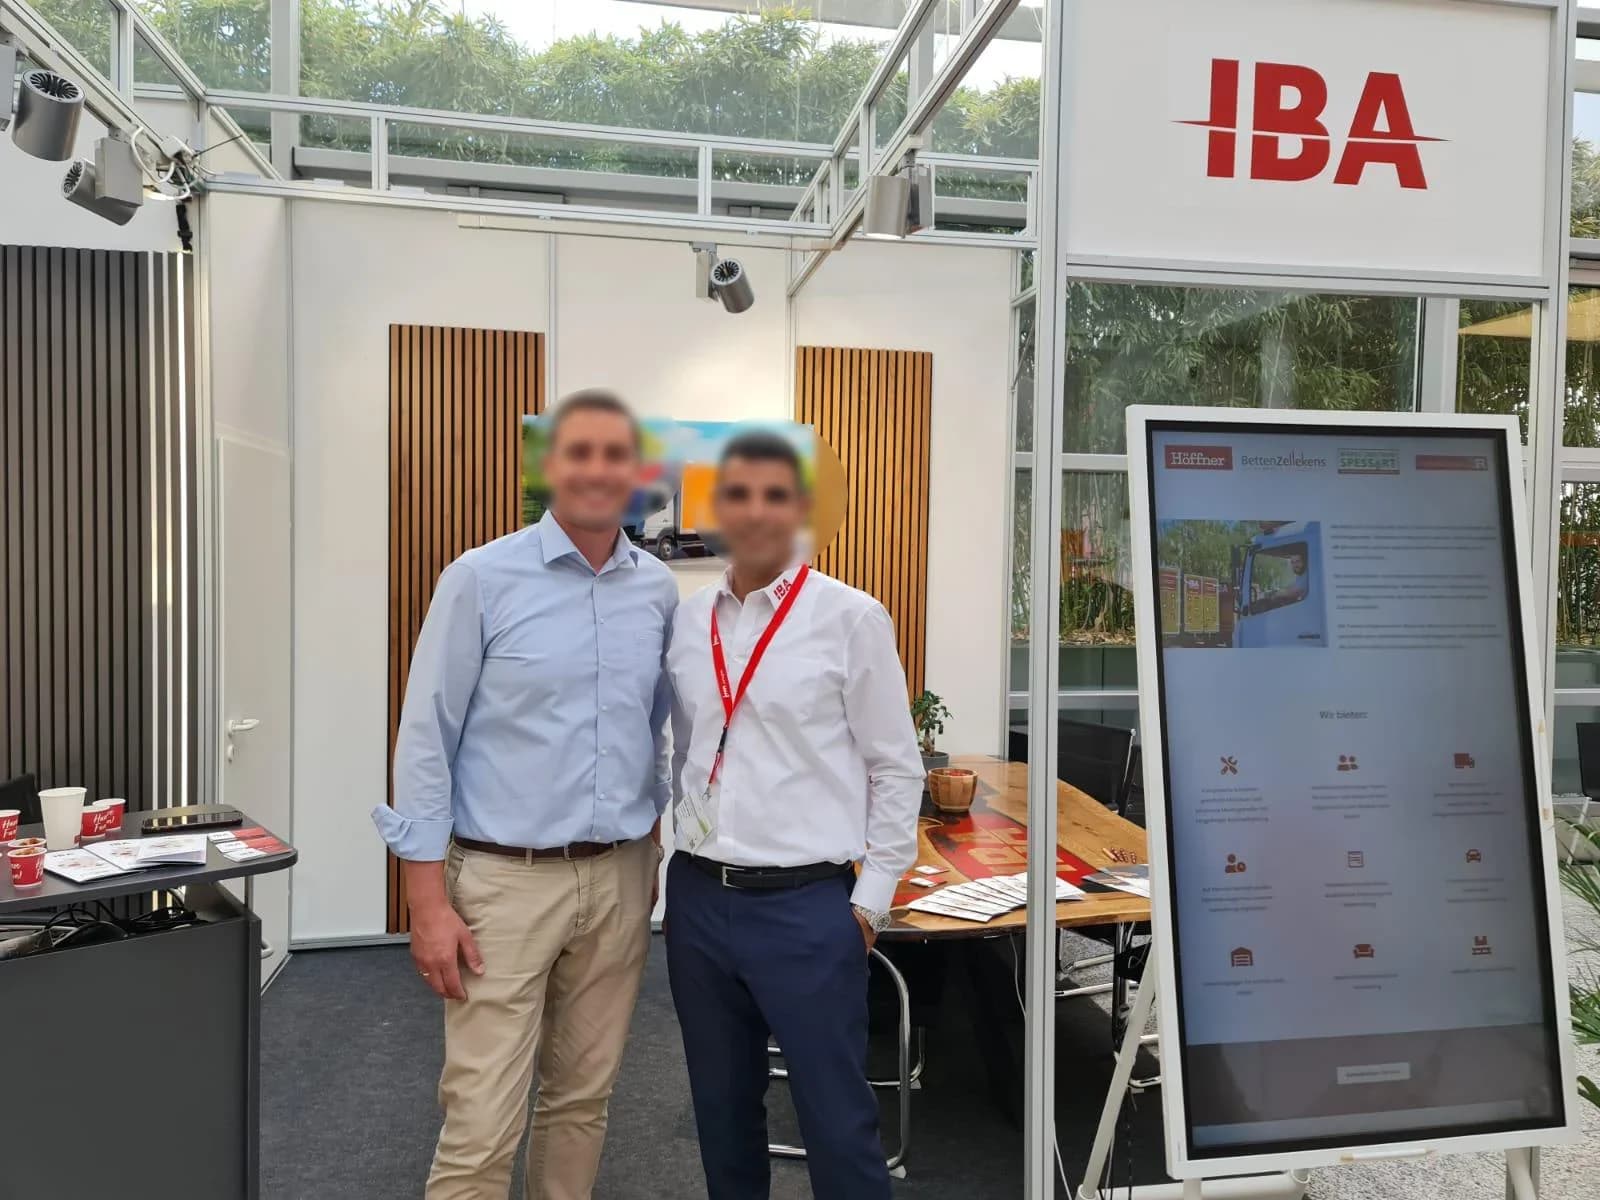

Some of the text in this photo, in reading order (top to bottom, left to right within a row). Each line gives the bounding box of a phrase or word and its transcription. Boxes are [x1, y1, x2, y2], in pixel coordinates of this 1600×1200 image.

[1171, 58, 1452, 190] IBA
[1170, 451, 1225, 466] Höffner
[1241, 449, 1327, 468] BettenZellekens
